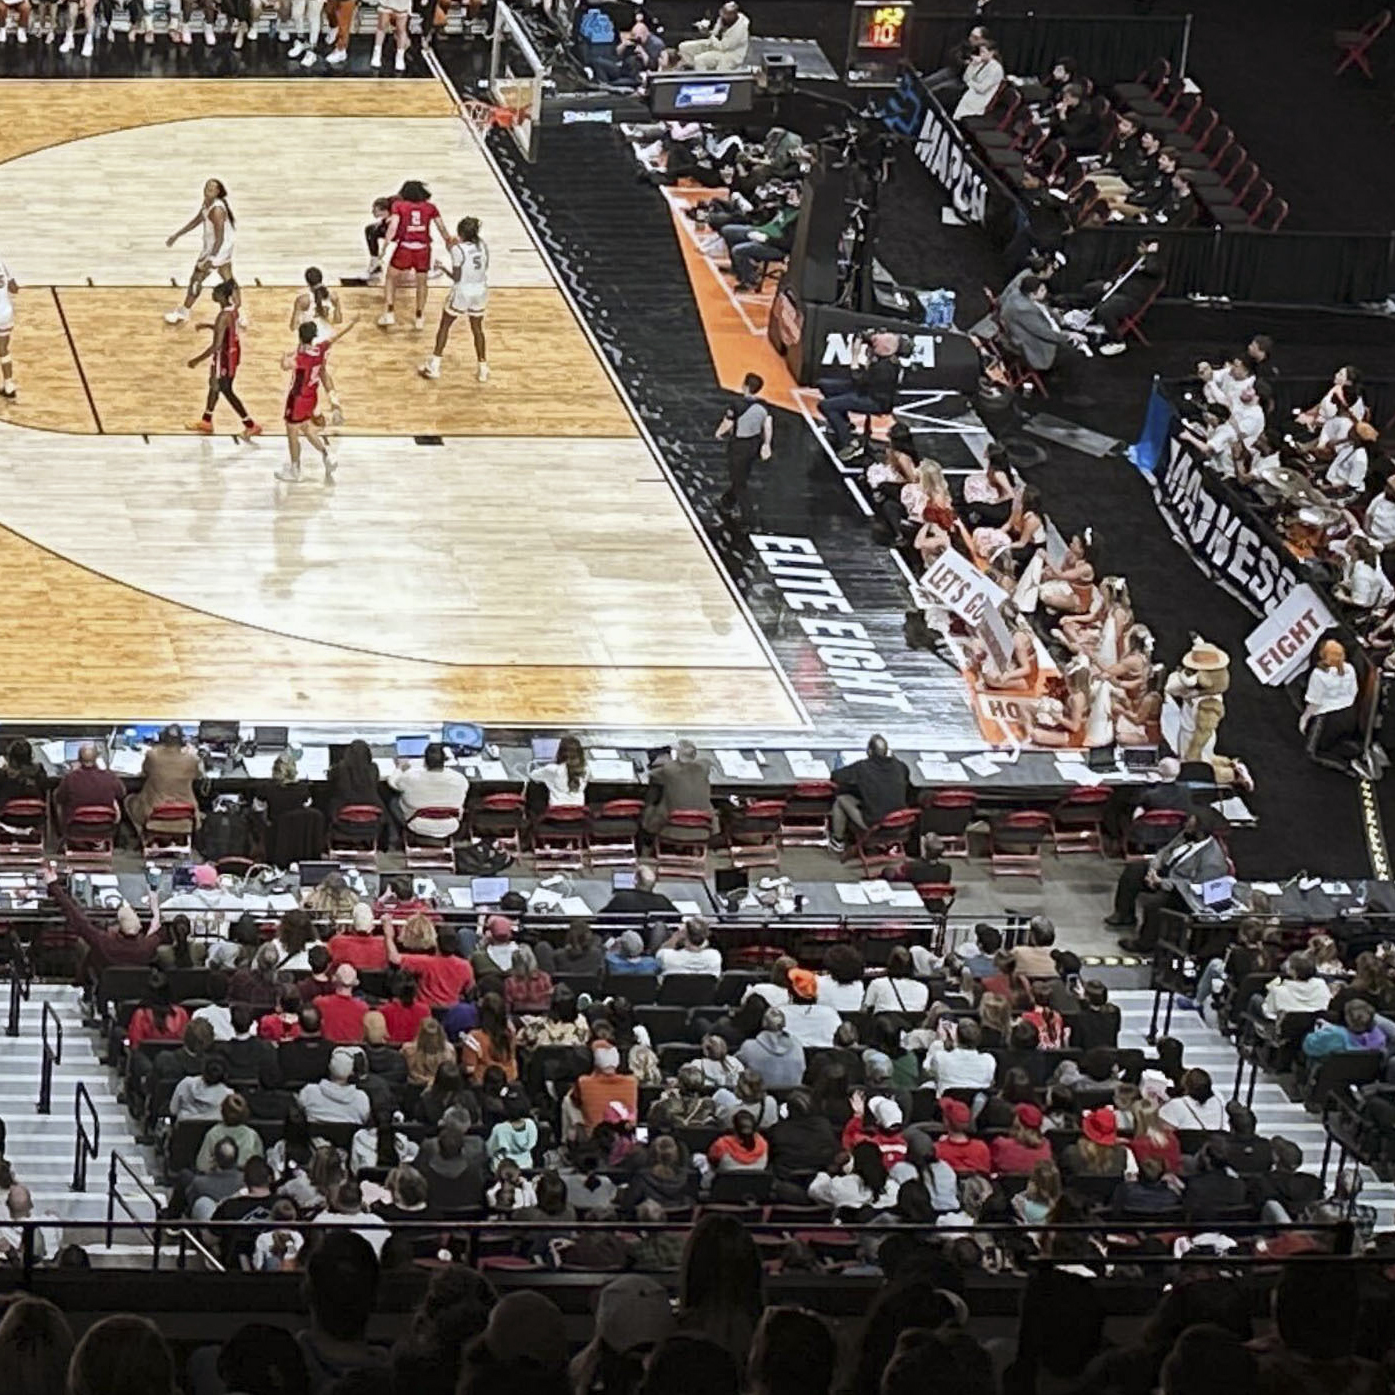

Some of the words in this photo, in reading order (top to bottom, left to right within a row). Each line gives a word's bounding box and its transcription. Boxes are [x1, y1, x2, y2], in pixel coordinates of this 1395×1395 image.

[473, 255, 481, 271] 5
[749, 533, 855, 614] ELITE
[926, 562, 973, 605] LET'S
[798, 616, 914, 714] EIGHT
[1256, 607, 1321, 680] FIGHT
